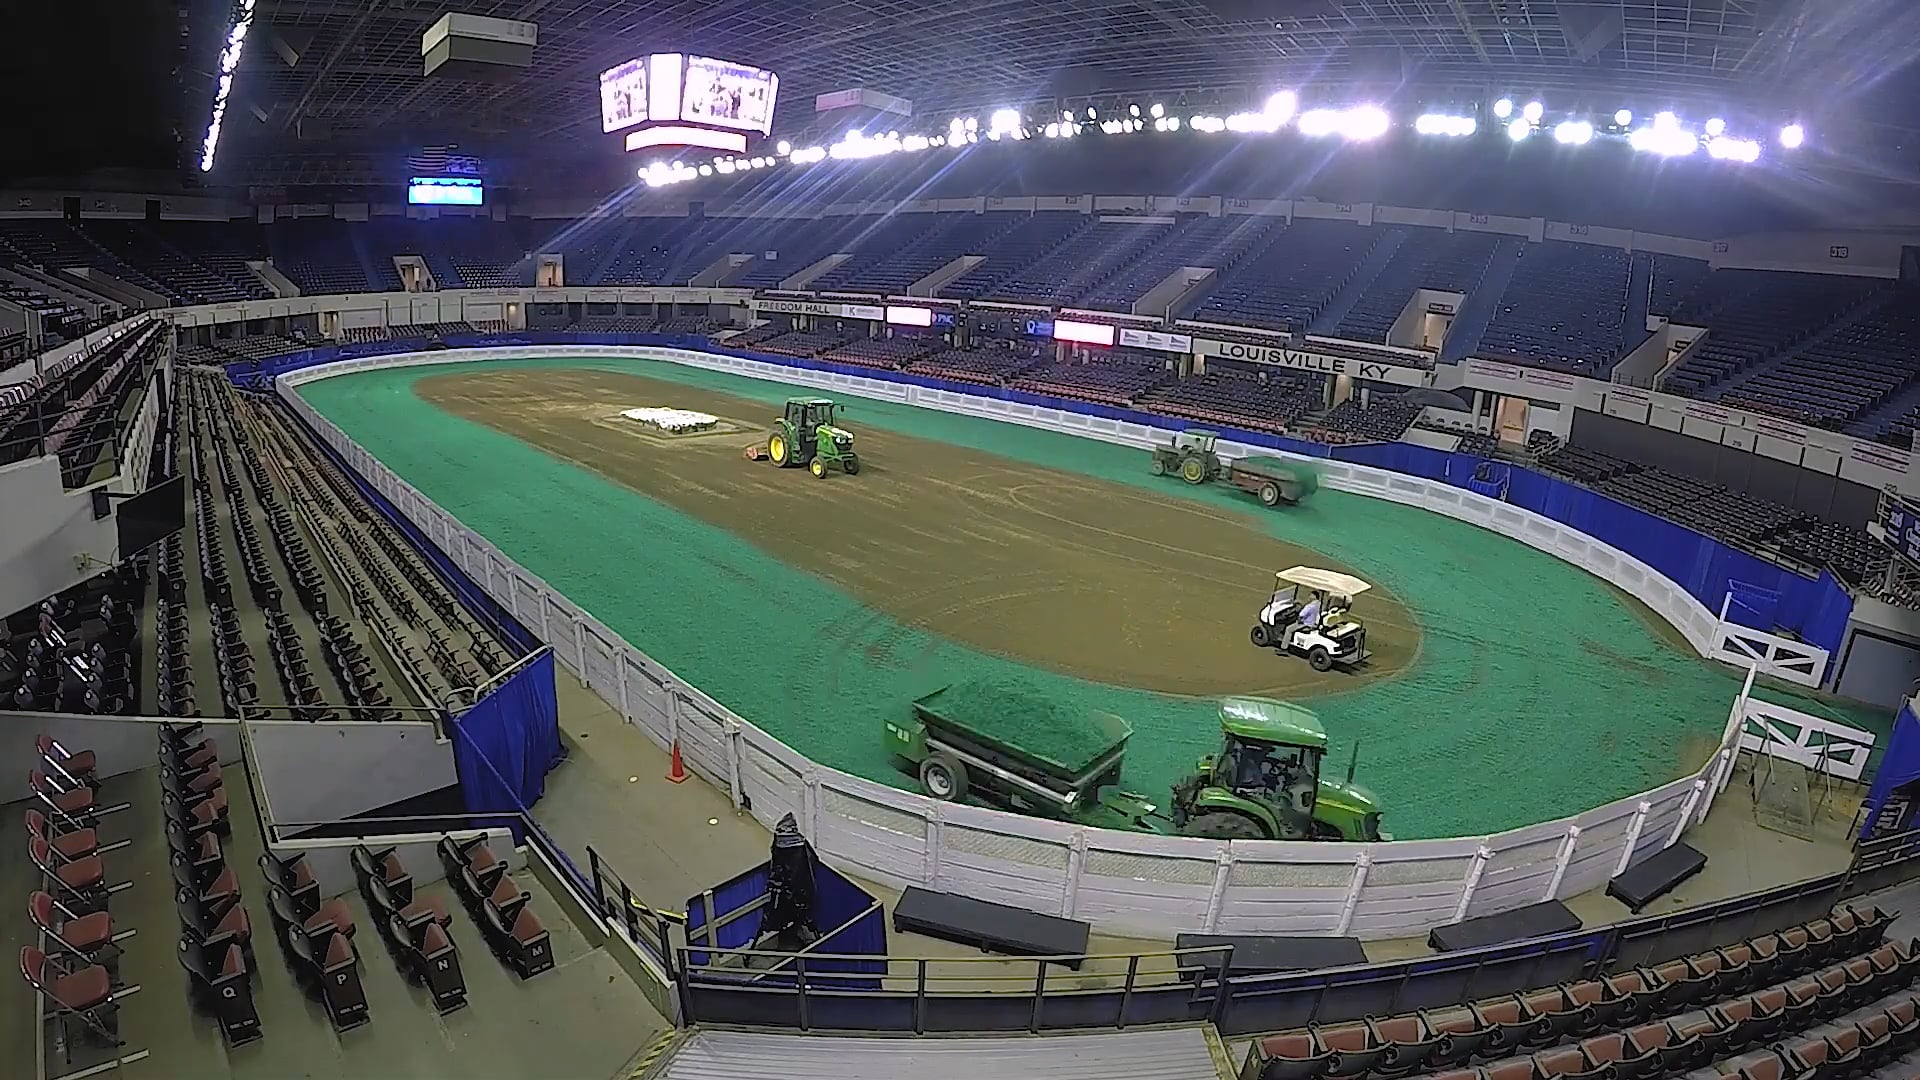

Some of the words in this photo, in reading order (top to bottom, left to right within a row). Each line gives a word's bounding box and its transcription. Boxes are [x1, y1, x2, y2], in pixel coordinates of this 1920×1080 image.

[758, 302, 802, 312] FREEDOM
[806, 305, 830, 314] HALL
[1220, 343, 1345, 372] LOUISVILLE
[1359, 363, 1391, 379] KY
[531, 945, 544, 957] M
[437, 959, 449, 971] N
[336, 973, 347, 985] P
[222, 986, 237, 998] Q
